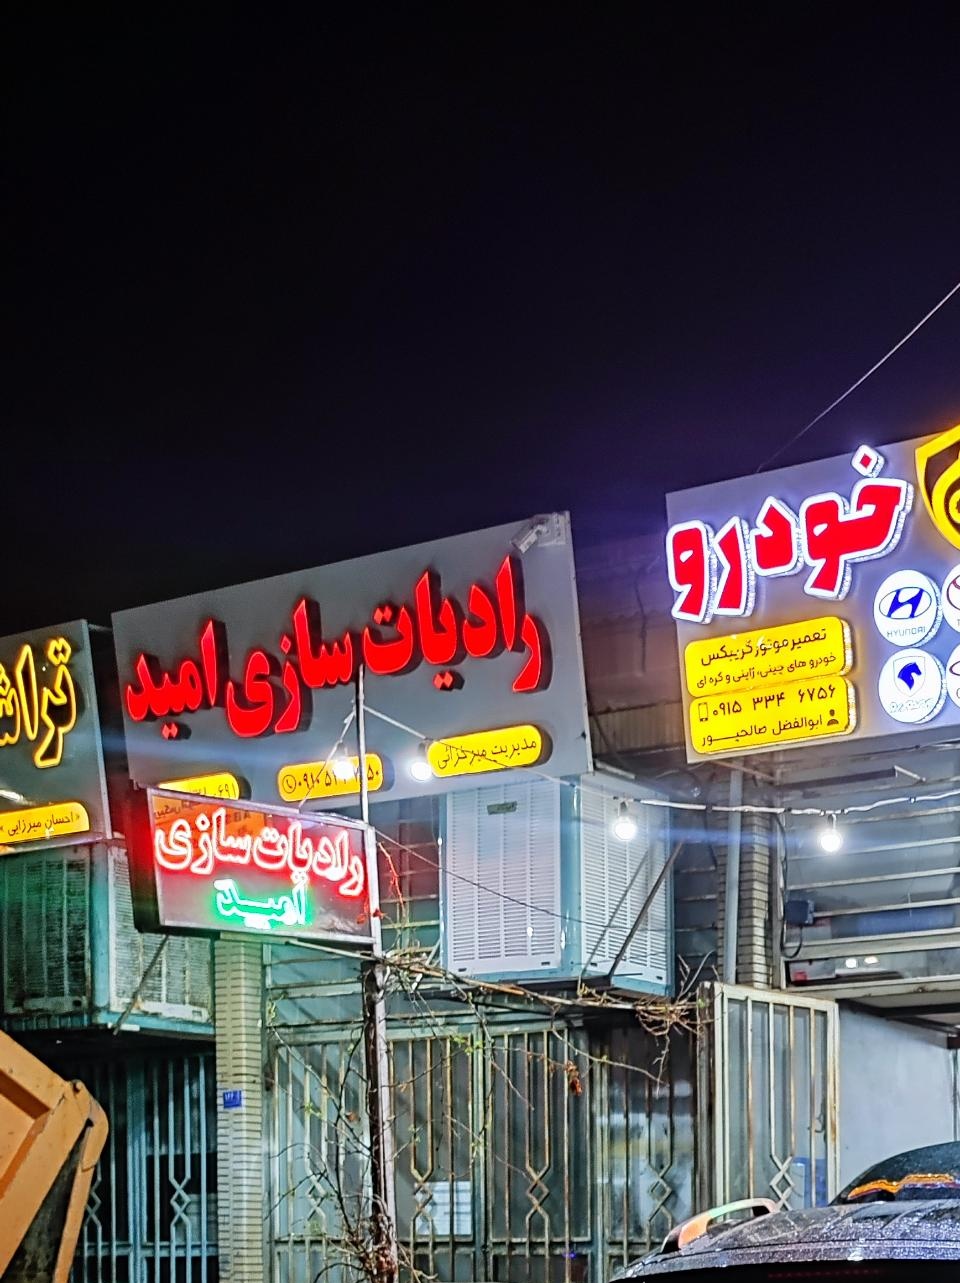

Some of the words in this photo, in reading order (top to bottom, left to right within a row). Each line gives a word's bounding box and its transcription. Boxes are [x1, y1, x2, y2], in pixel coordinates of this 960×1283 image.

[666, 445, 911, 623] خودرو
[362, 553, 542, 693] رادیات
[791, 628, 826, 650] تعمیر
[126, 619, 217, 741] امید
[226, 598, 353, 738] سازی
[725, 673, 731, 684] و
[787, 659, 807, 673] های
[809, 652, 836, 669] خودرو
[712, 700, 742, 716] ۰۹۱۵
[752, 691, 785, 711] ۳۳۴
[798, 683, 836, 703] ۶۷۵۶
[771, 714, 823, 736] ابوالفضل
[492, 739, 537, 759] مدیریت
[155, 807, 252, 875] سازی
[252, 822, 365, 896] رادیات
[213, 879, 308, 929] امید
